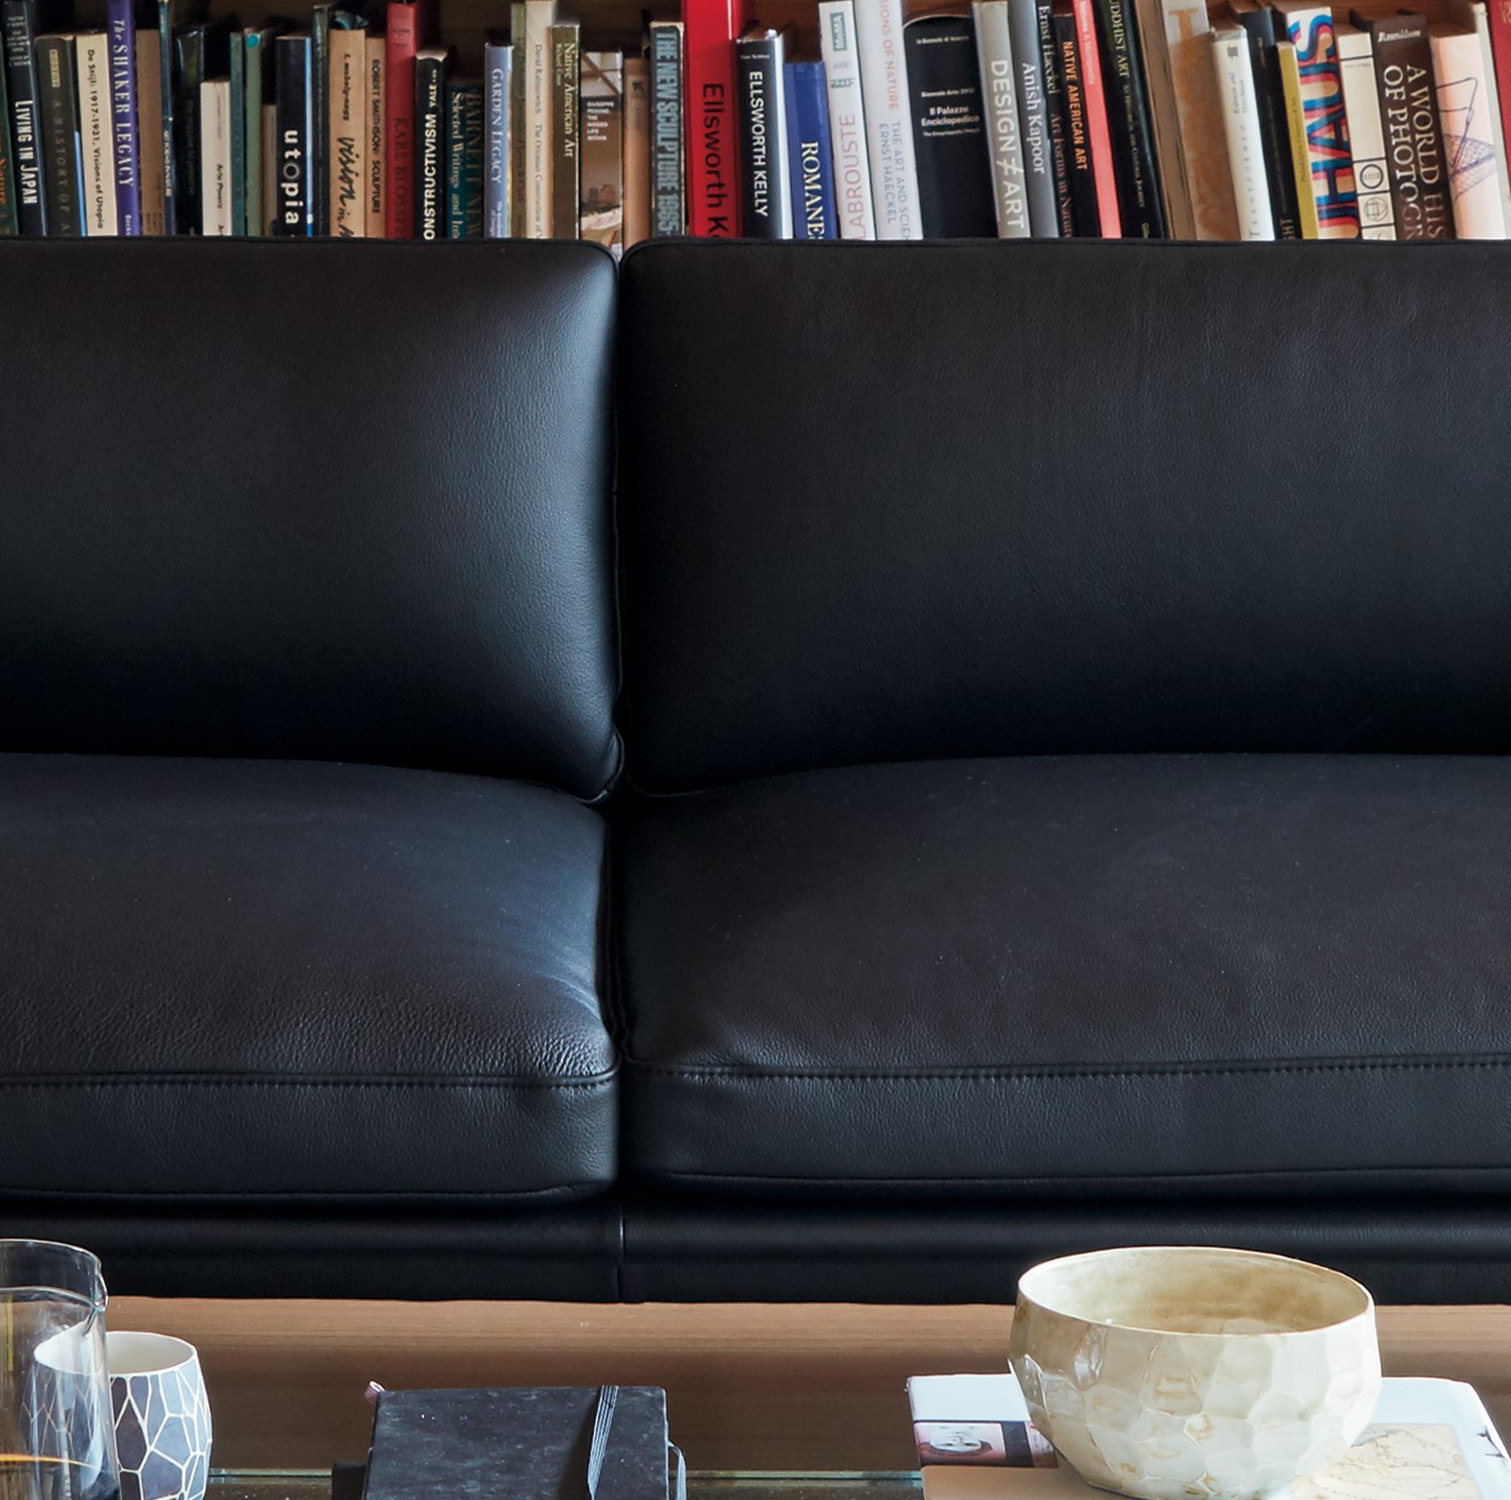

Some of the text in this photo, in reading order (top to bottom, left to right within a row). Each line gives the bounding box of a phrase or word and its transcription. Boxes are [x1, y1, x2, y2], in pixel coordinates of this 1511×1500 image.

[749, 72, 768, 216] ELLSWORTH KELLY
[1022, 62, 1047, 174] Anish Kapoor
[281, 130, 302, 225] utopia
